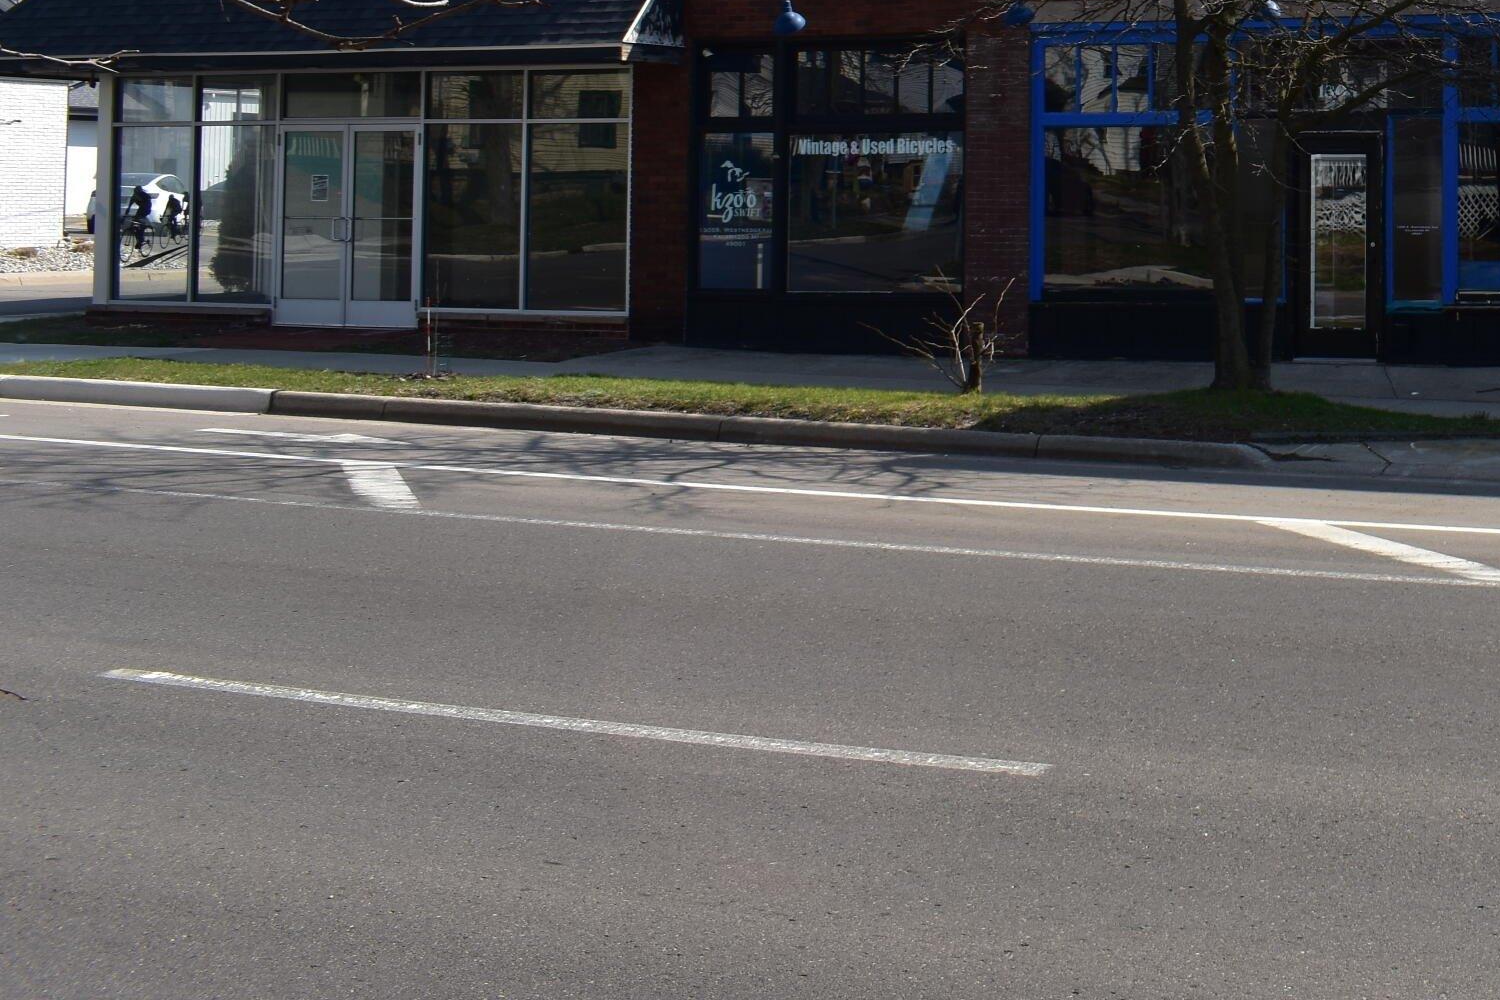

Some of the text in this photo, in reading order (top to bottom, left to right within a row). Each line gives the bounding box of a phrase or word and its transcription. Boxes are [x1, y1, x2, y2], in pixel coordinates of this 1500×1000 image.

[798, 137, 953, 157] Vintage & Used Bicycles
[734, 208, 762, 217] SWIFT
